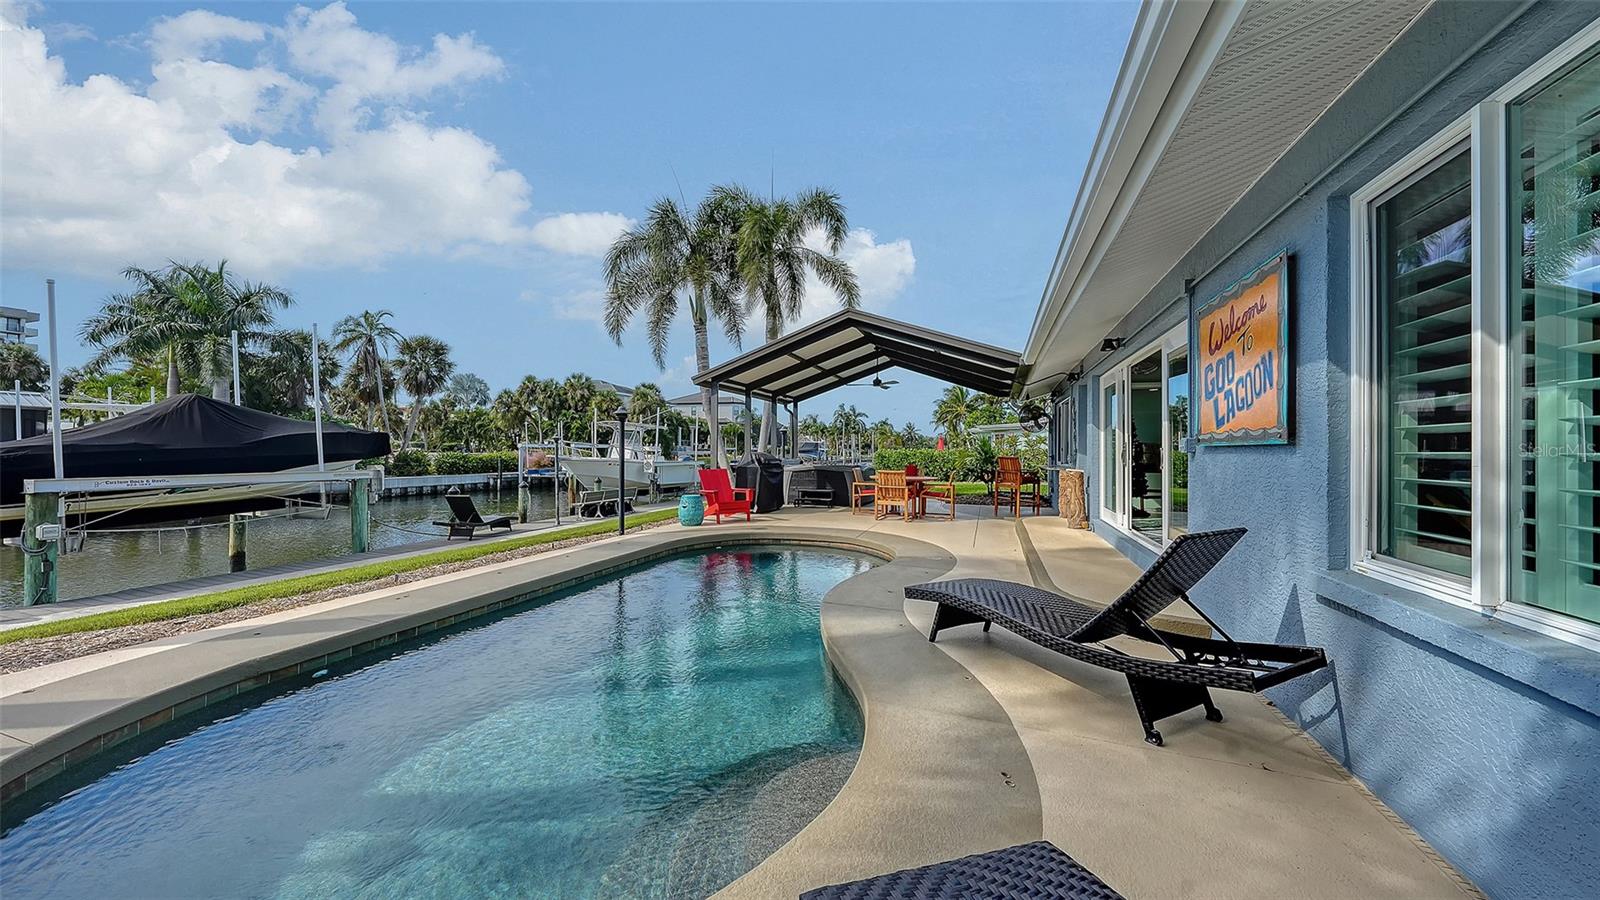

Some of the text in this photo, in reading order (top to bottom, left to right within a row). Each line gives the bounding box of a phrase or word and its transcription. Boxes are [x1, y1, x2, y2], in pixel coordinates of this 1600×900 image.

[1208, 294, 1267, 356] Welcome
[1237, 325, 1253, 356] To
[1213, 351, 1274, 429] LAGOON
